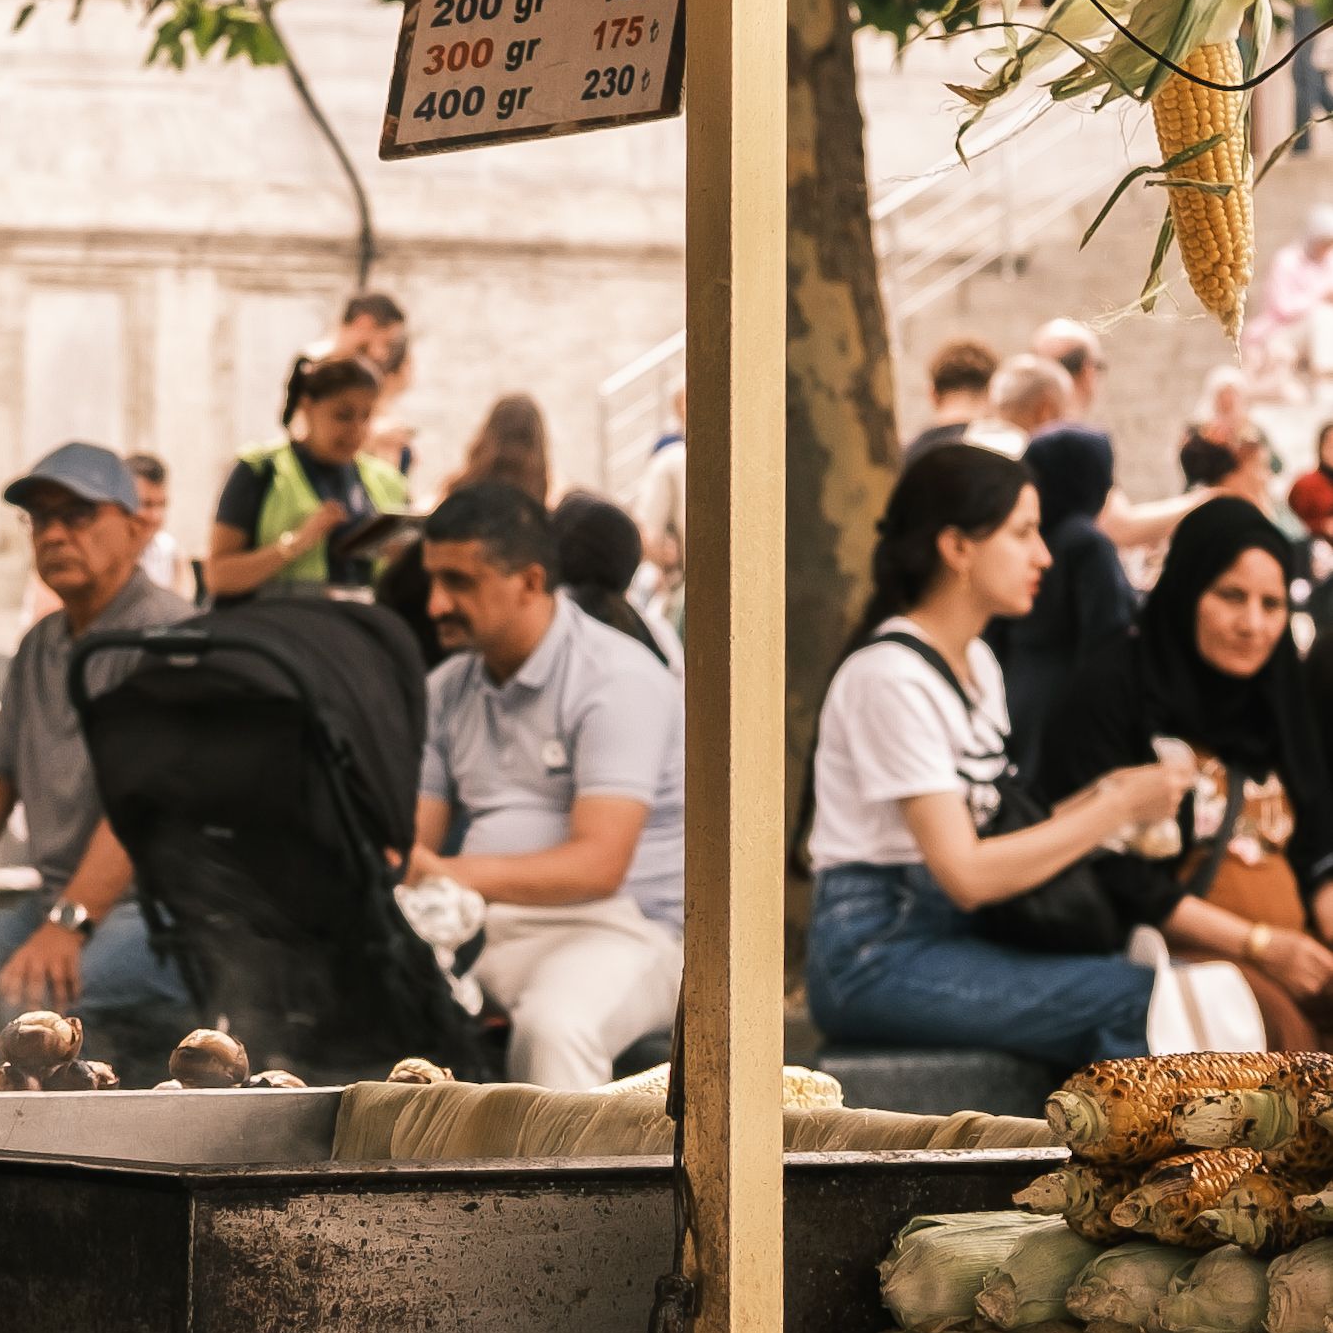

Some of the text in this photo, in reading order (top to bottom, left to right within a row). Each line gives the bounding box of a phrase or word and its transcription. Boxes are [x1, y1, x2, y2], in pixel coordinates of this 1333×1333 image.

[423, 36, 494, 76] 300
[504, 35, 542, 72] gr
[592, 14, 645, 51] 175
[412, 84, 486, 123] 400
[496, 83, 533, 121] gr
[581, 63, 636, 101] 230
